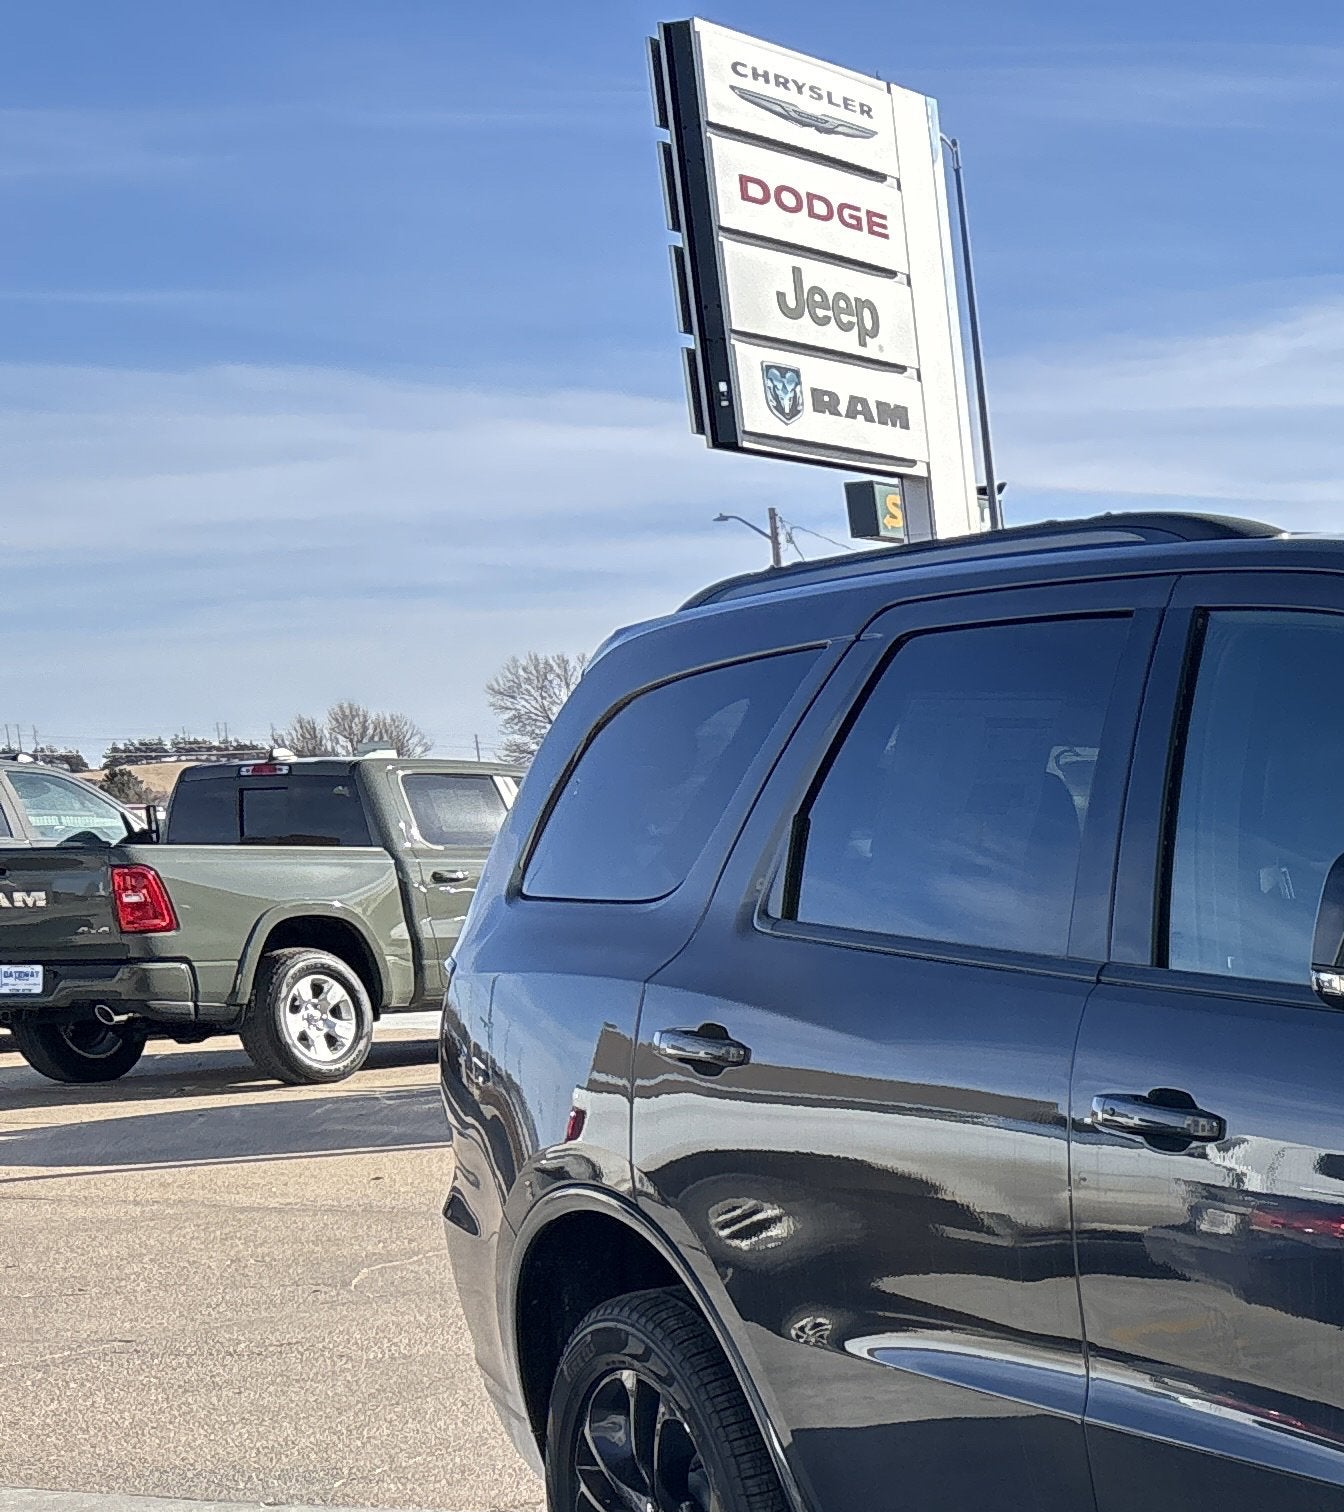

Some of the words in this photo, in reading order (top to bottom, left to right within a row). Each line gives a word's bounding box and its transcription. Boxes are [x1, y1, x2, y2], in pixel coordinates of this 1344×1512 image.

[730, 61, 874, 120] CHRYSLER
[738, 173, 890, 240] DODGE
[776, 266, 880, 347] Jeep
[810, 386, 911, 431] RAM
